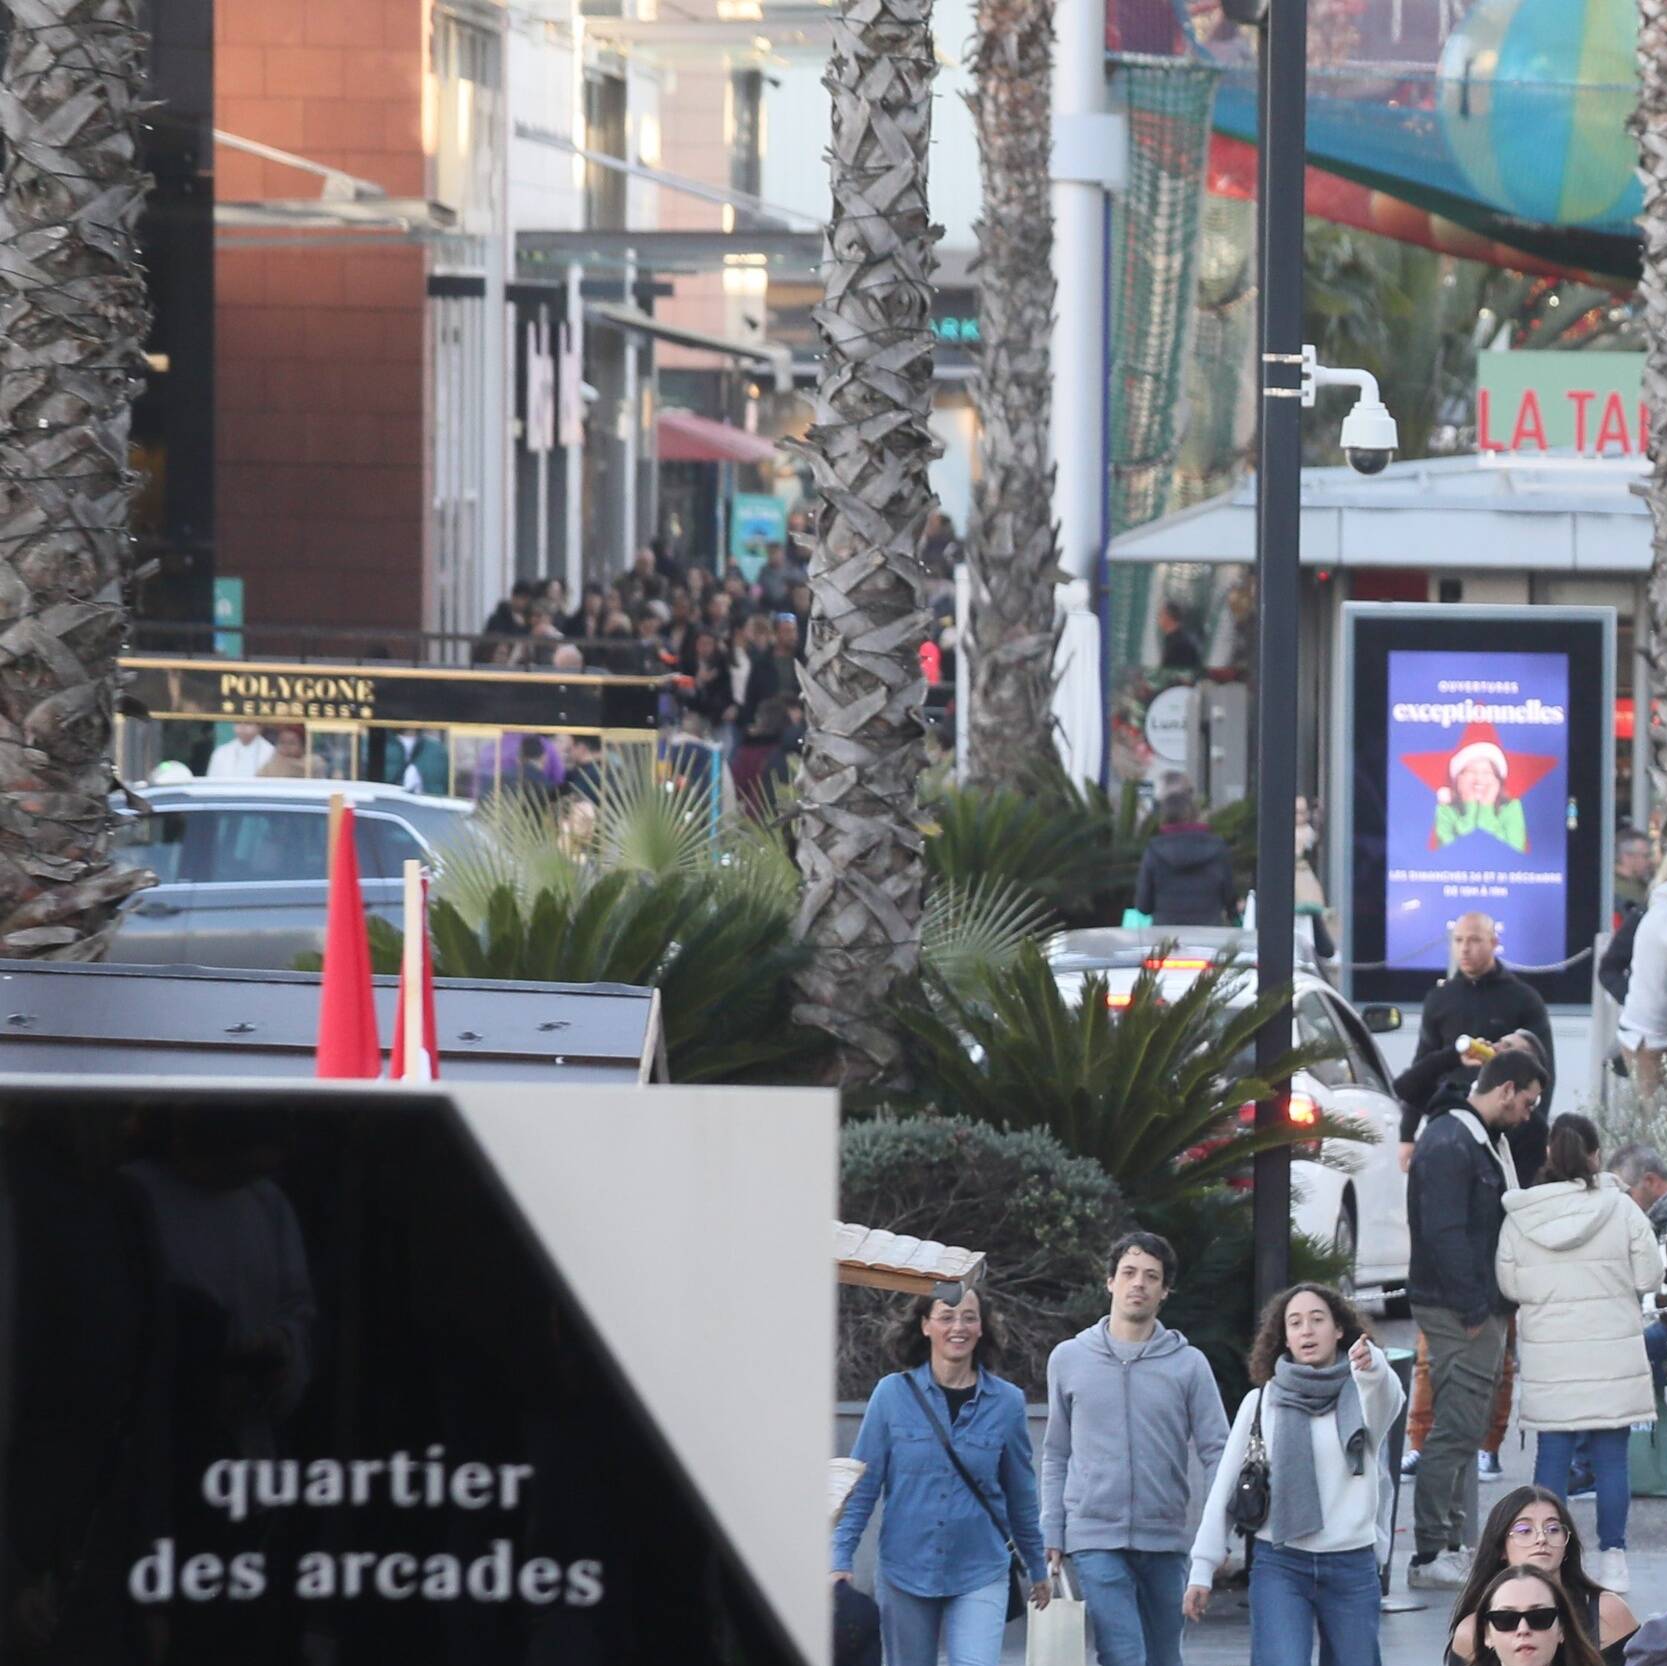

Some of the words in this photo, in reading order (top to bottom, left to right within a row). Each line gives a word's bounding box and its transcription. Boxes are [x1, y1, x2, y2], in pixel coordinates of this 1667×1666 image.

[1477, 388, 1548, 452] LA
[220, 674, 375, 702] POLYGONE
[243, 701, 352, 718] EXPRESS
[1392, 698, 1566, 729] exceptionnelles
[202, 1444, 534, 1522] quartier
[128, 1538, 268, 1604] des
[295, 1538, 604, 1607] arcades
